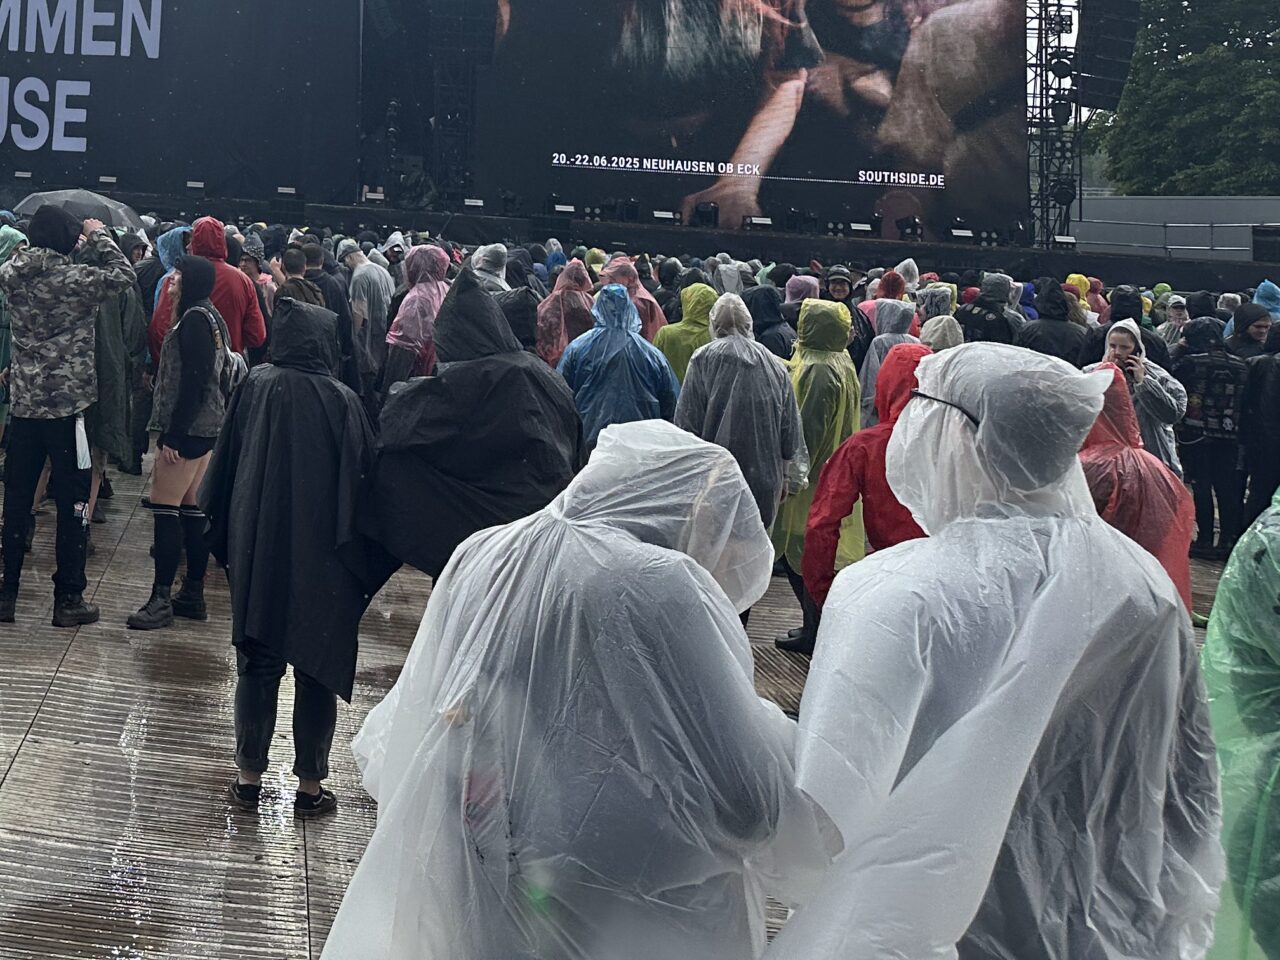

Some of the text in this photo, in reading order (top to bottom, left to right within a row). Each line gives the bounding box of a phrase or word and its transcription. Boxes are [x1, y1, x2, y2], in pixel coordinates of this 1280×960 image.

[552, 152, 760, 176] 20.-22.06.2025 NEUHAUSEN OB ECK
[858, 169, 945, 186] SOUTHSIDE.DE
